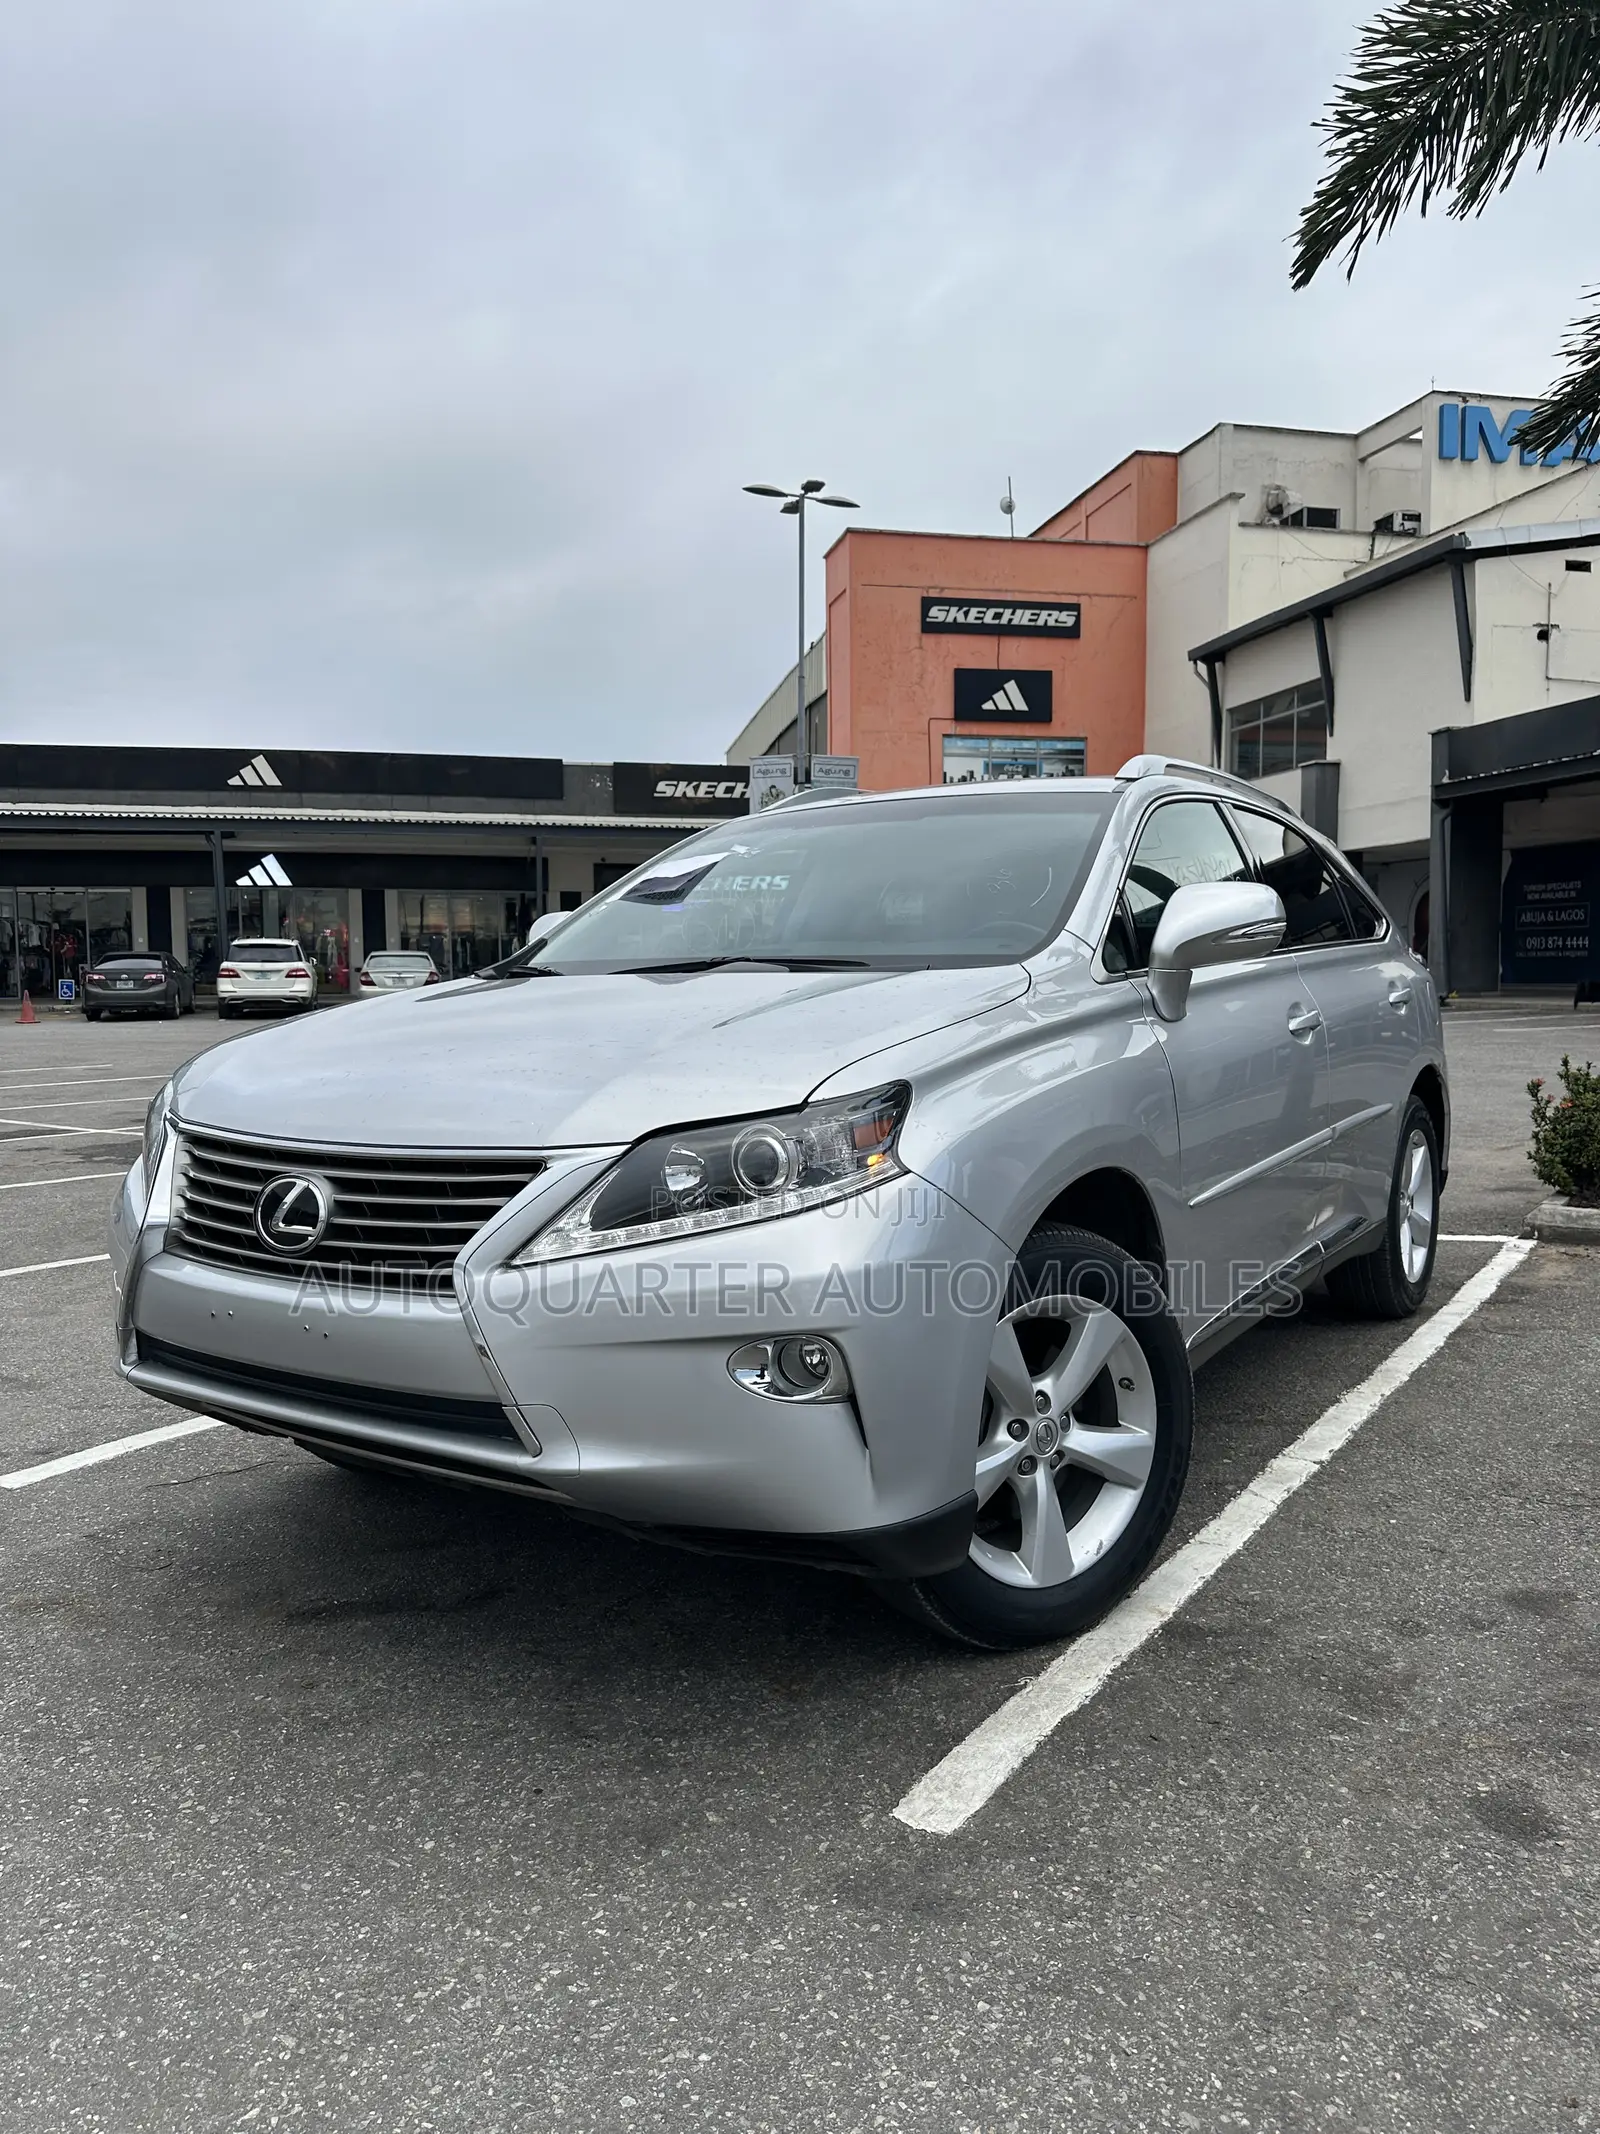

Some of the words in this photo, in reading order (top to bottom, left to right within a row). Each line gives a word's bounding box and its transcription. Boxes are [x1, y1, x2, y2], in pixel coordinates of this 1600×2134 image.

[926, 605, 1078, 628] SKECHERS
[1520, 911, 1546, 924] ABUJA
[1547, 910, 1554, 922] &
[1555, 909, 1585, 922] LAGOS
[1526, 936, 1546, 949] 0913
[1547, 936, 1563, 949] 874
[1565, 935, 1589, 949] 4444
